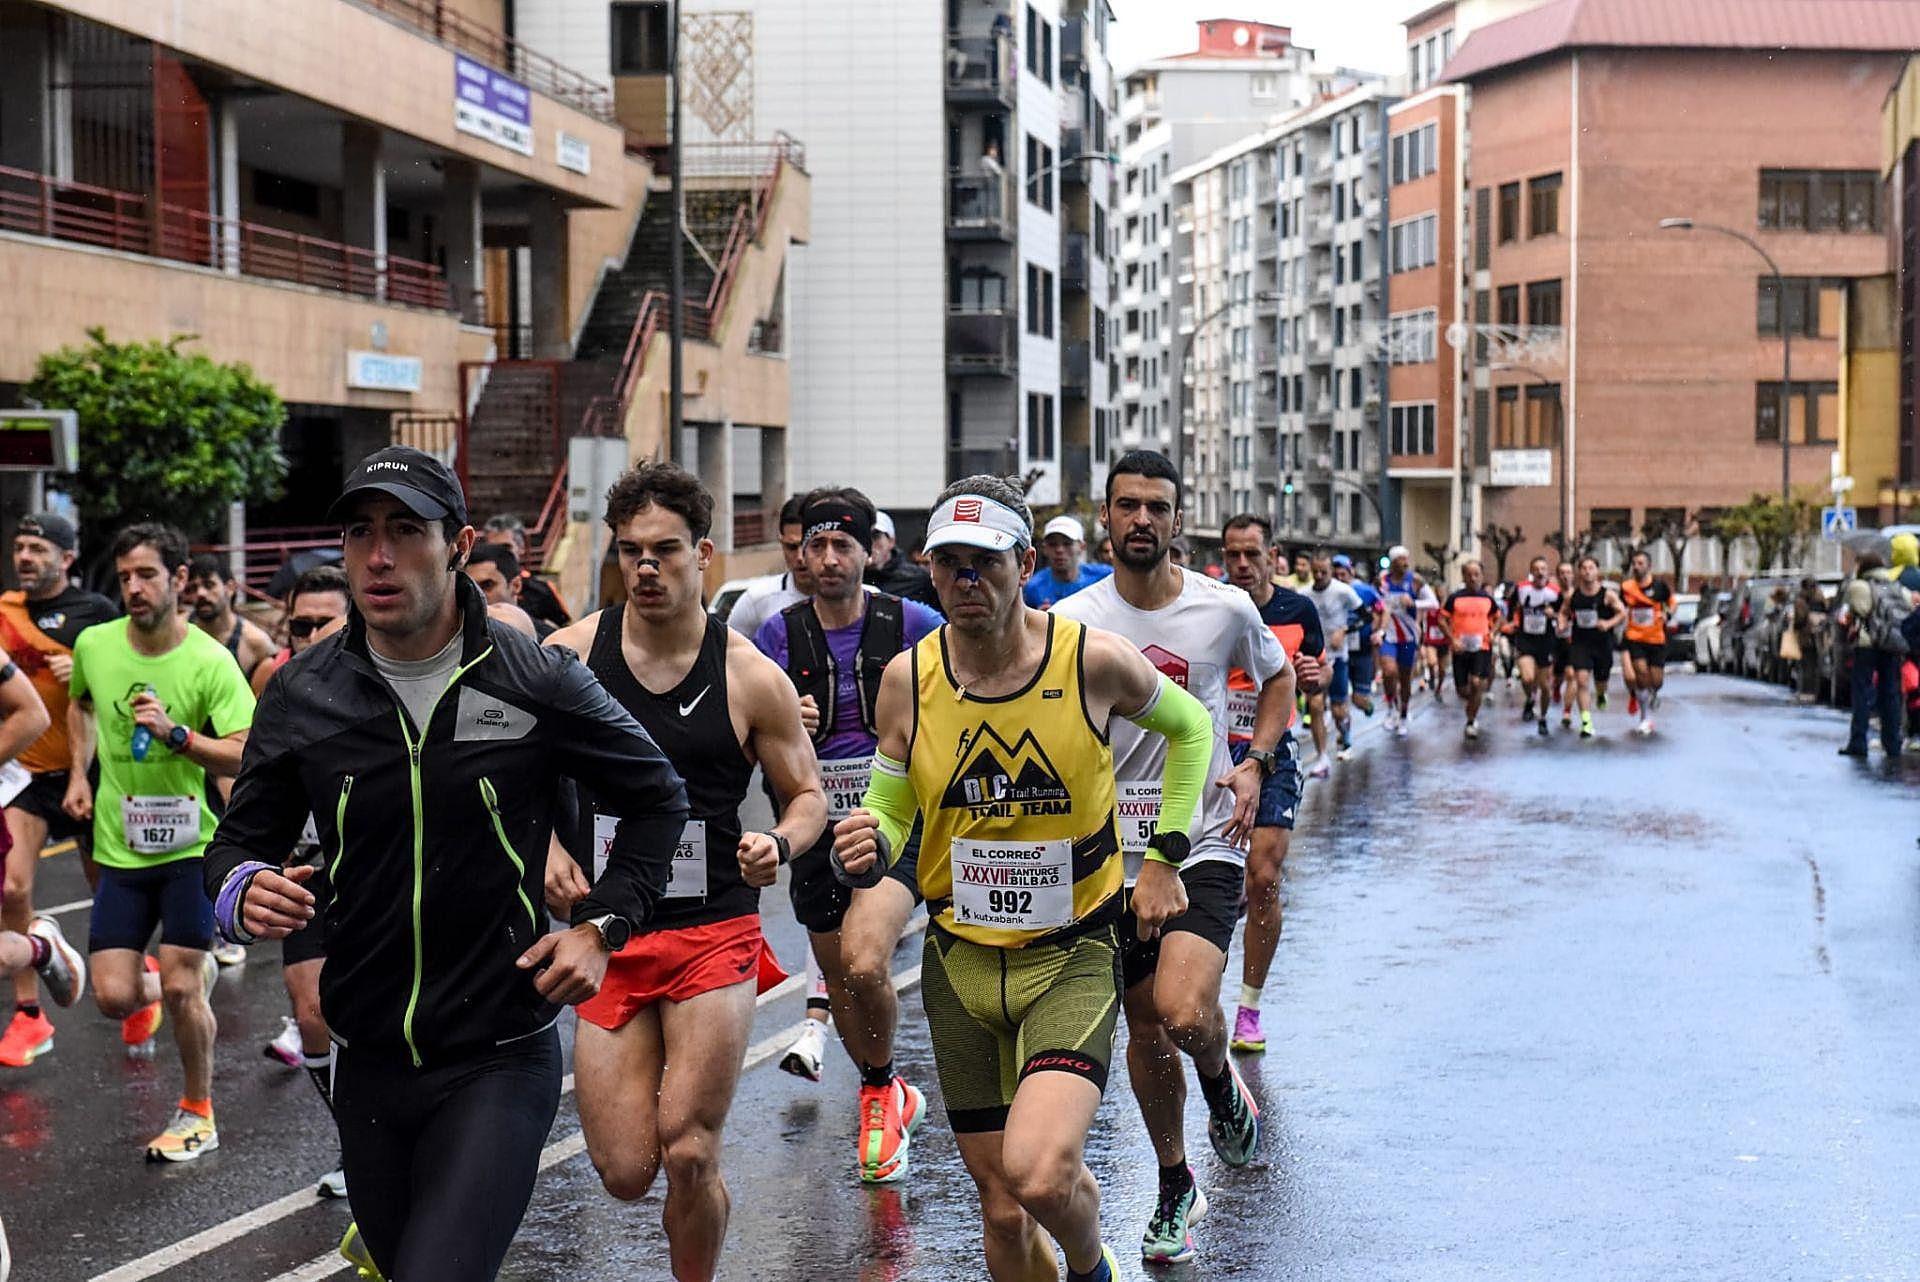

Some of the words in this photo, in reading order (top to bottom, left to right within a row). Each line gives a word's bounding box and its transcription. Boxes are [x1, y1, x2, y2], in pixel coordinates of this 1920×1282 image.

[366, 461, 408, 473] KIPRUN
[822, 765, 833, 773] EL
[834, 762, 871, 773] CORREO
[1009, 787, 1030, 799] Trail
[1031, 785, 1065, 799] Running
[1125, 788, 1136, 796] EL
[1020, 800, 1072, 817] TEAM
[1117, 802, 1153, 816] XXXVII
[142, 828, 175, 843] 1627
[972, 848, 986, 859] EL
[988, 850, 1041, 860] CORREO
[961, 864, 1008, 886] XXXVII
[1010, 866, 1059, 877] SANTURCE
[1009, 875, 1059, 887] BILBAO
[988, 889, 1032, 914] 992
[973, 912, 1025, 925] kutxabank
